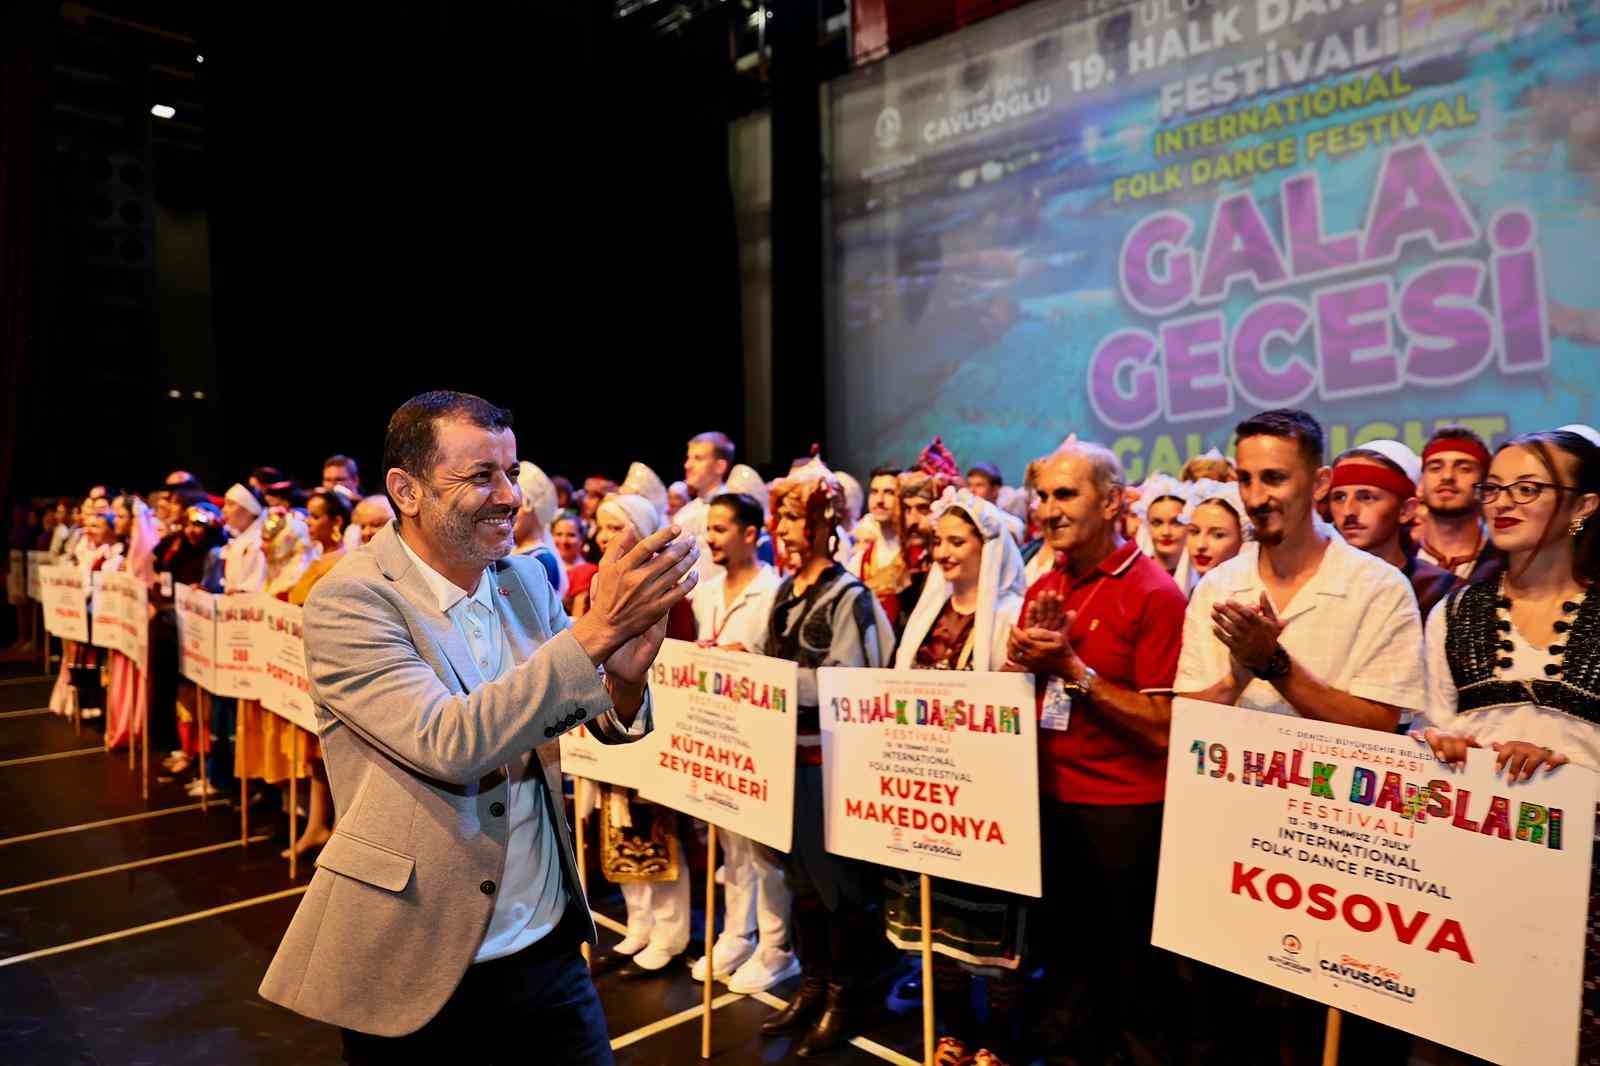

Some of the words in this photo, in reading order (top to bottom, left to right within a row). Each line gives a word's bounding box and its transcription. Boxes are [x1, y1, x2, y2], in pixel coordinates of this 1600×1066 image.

[1068, 53, 1116, 92] 19.
[1128, 7, 1242, 74] HALK
[1160, 4, 1399, 118] FESTİVALİ
[1154, 66, 1412, 158] INTERNATIONAL
[1113, 167, 1183, 201] FOLK
[1190, 137, 1297, 185] DANCE
[1307, 96, 1478, 159] FESTIVAL
[1120, 142, 1480, 316] GALA
[1088, 208, 1550, 431] GECESİ
[671, 664, 708, 693] HALK
[831, 697, 857, 724] 19.
[859, 693, 909, 725] HALK
[659, 752, 768, 802] ZEYBEKLERİ
[880, 775, 959, 807] KUZEY
[1189, 739, 1236, 783] 19.
[1241, 748, 1339, 801] HALK
[845, 798, 1007, 846] MAKEDONYA
[1286, 798, 1417, 839] FESTİVALİ
[1322, 824, 1371, 844] TEMMUZ
[1381, 838, 1412, 852] JULY
[1251, 838, 1293, 859] FOLK
[1298, 849, 1358, 876] DANCE
[1364, 866, 1452, 900] FESTIVAL
[1279, 827, 1421, 873] INTERNATIONAL
[1230, 861, 1476, 965] KOSOVA
